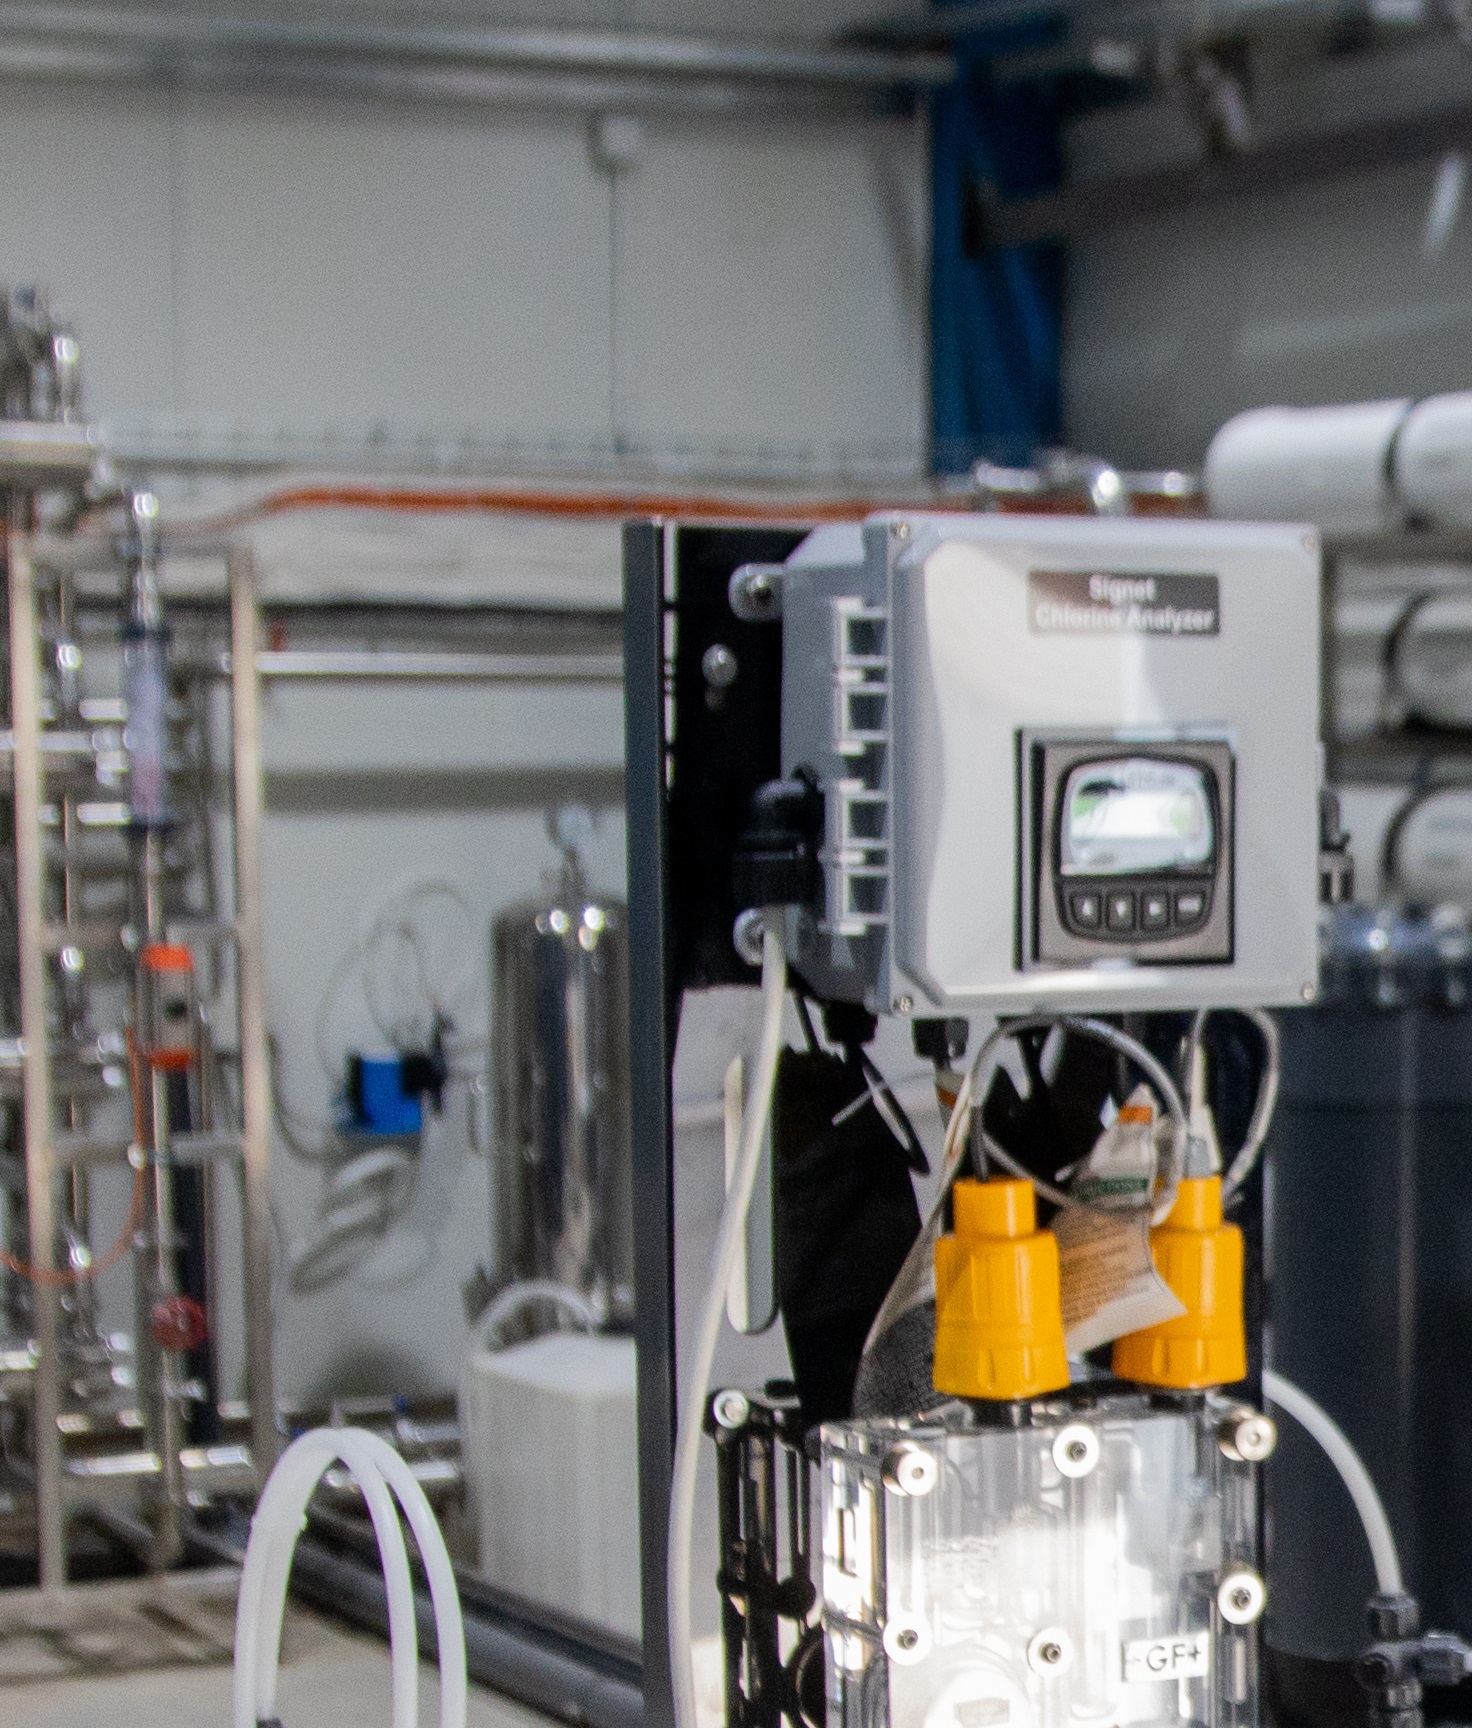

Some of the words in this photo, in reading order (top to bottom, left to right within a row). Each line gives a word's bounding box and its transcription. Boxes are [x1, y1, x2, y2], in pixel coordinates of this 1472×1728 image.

[1089, 574, 1156, 605] Signet
[1035, 602, 1122, 628] Chlorine
[1126, 604, 1214, 635] Analyzer
